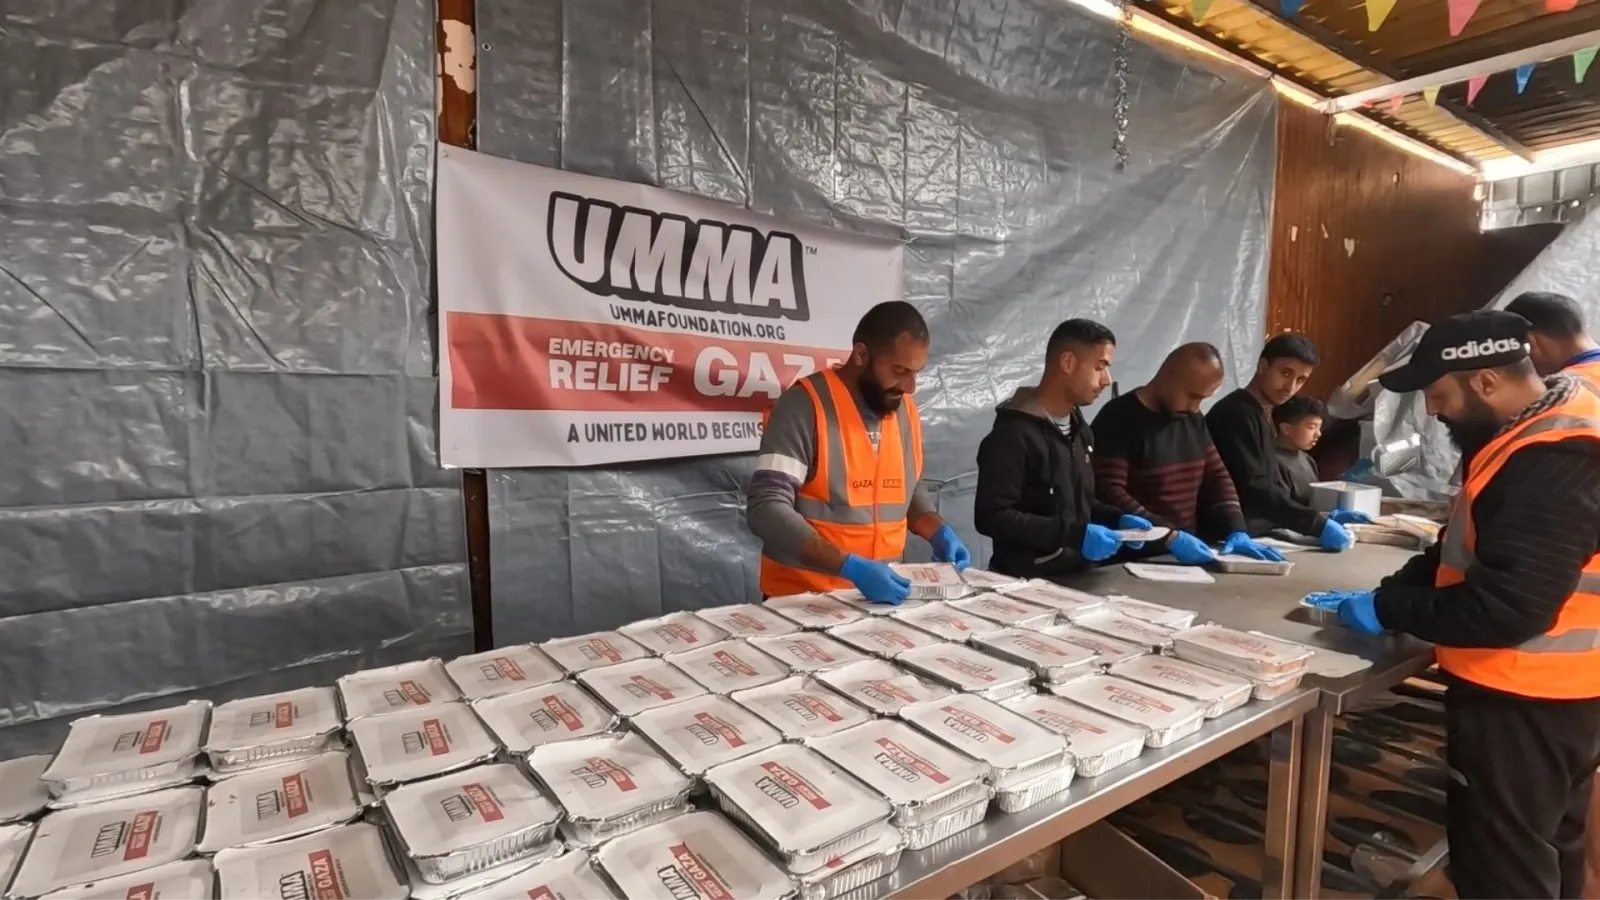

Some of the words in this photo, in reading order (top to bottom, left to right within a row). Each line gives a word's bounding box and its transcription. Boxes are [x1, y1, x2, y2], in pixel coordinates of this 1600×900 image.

[547, 191, 810, 321] UMMA
[609, 304, 786, 341] UMMAFOUNDATION.ORG
[548, 338, 675, 362] EMERGENCY
[1441, 337, 1521, 361] adidas
[548, 359, 673, 392] RELIEF
[694, 346, 843, 400] GAZ
[567, 424, 581, 443] A
[584, 422, 648, 443] UNITED
[652, 422, 709, 442] WORLD
[712, 421, 764, 440] BEGINS
[770, 765, 799, 786] GAZA
[874, 752, 920, 783] UMMA
[755, 776, 799, 809] UMMA
[312, 857, 333, 888] GAZA
[678, 852, 707, 880] GAZA
